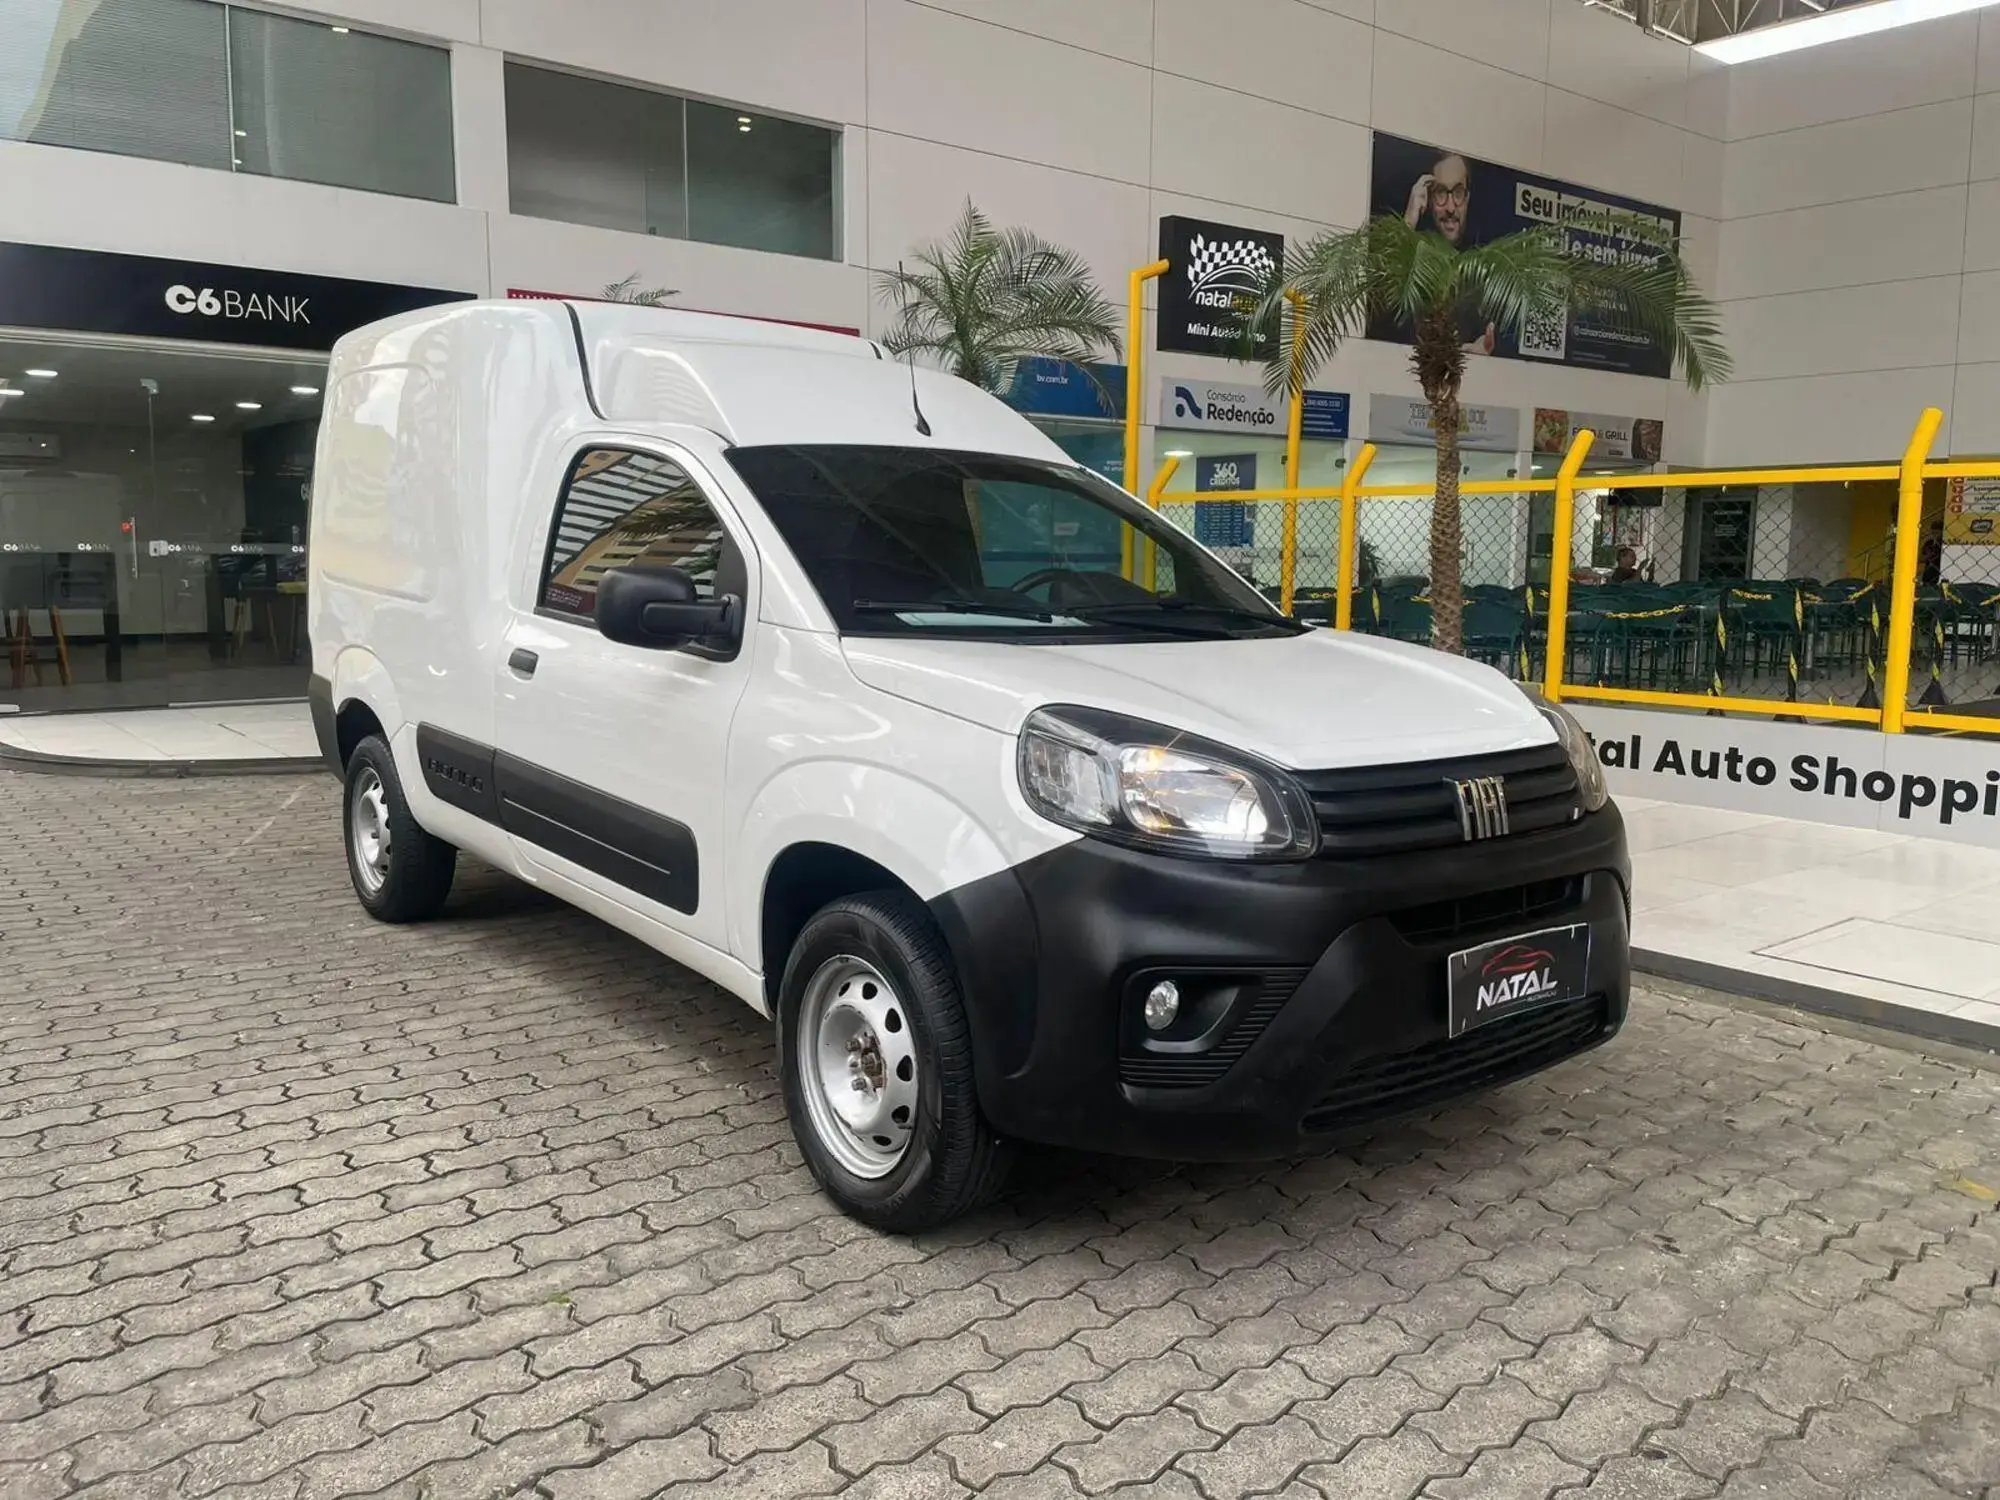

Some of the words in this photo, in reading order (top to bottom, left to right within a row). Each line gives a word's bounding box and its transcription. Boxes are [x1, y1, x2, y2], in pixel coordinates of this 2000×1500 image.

[1520, 189, 1553, 218] Seu
[1187, 323, 1210, 336] Mini
[1036, 374, 1069, 385] bv.com.br
[1206, 389, 1246, 403] Consórcio
[1207, 403, 1275, 427] Redenção
[1213, 462, 1238, 479] 360
[1653, 739, 1777, 785] Auto
[1789, 754, 2000, 825] Shoppi
[1455, 775, 1510, 841] FIAT
[1476, 967, 1558, 1012] NATAL
